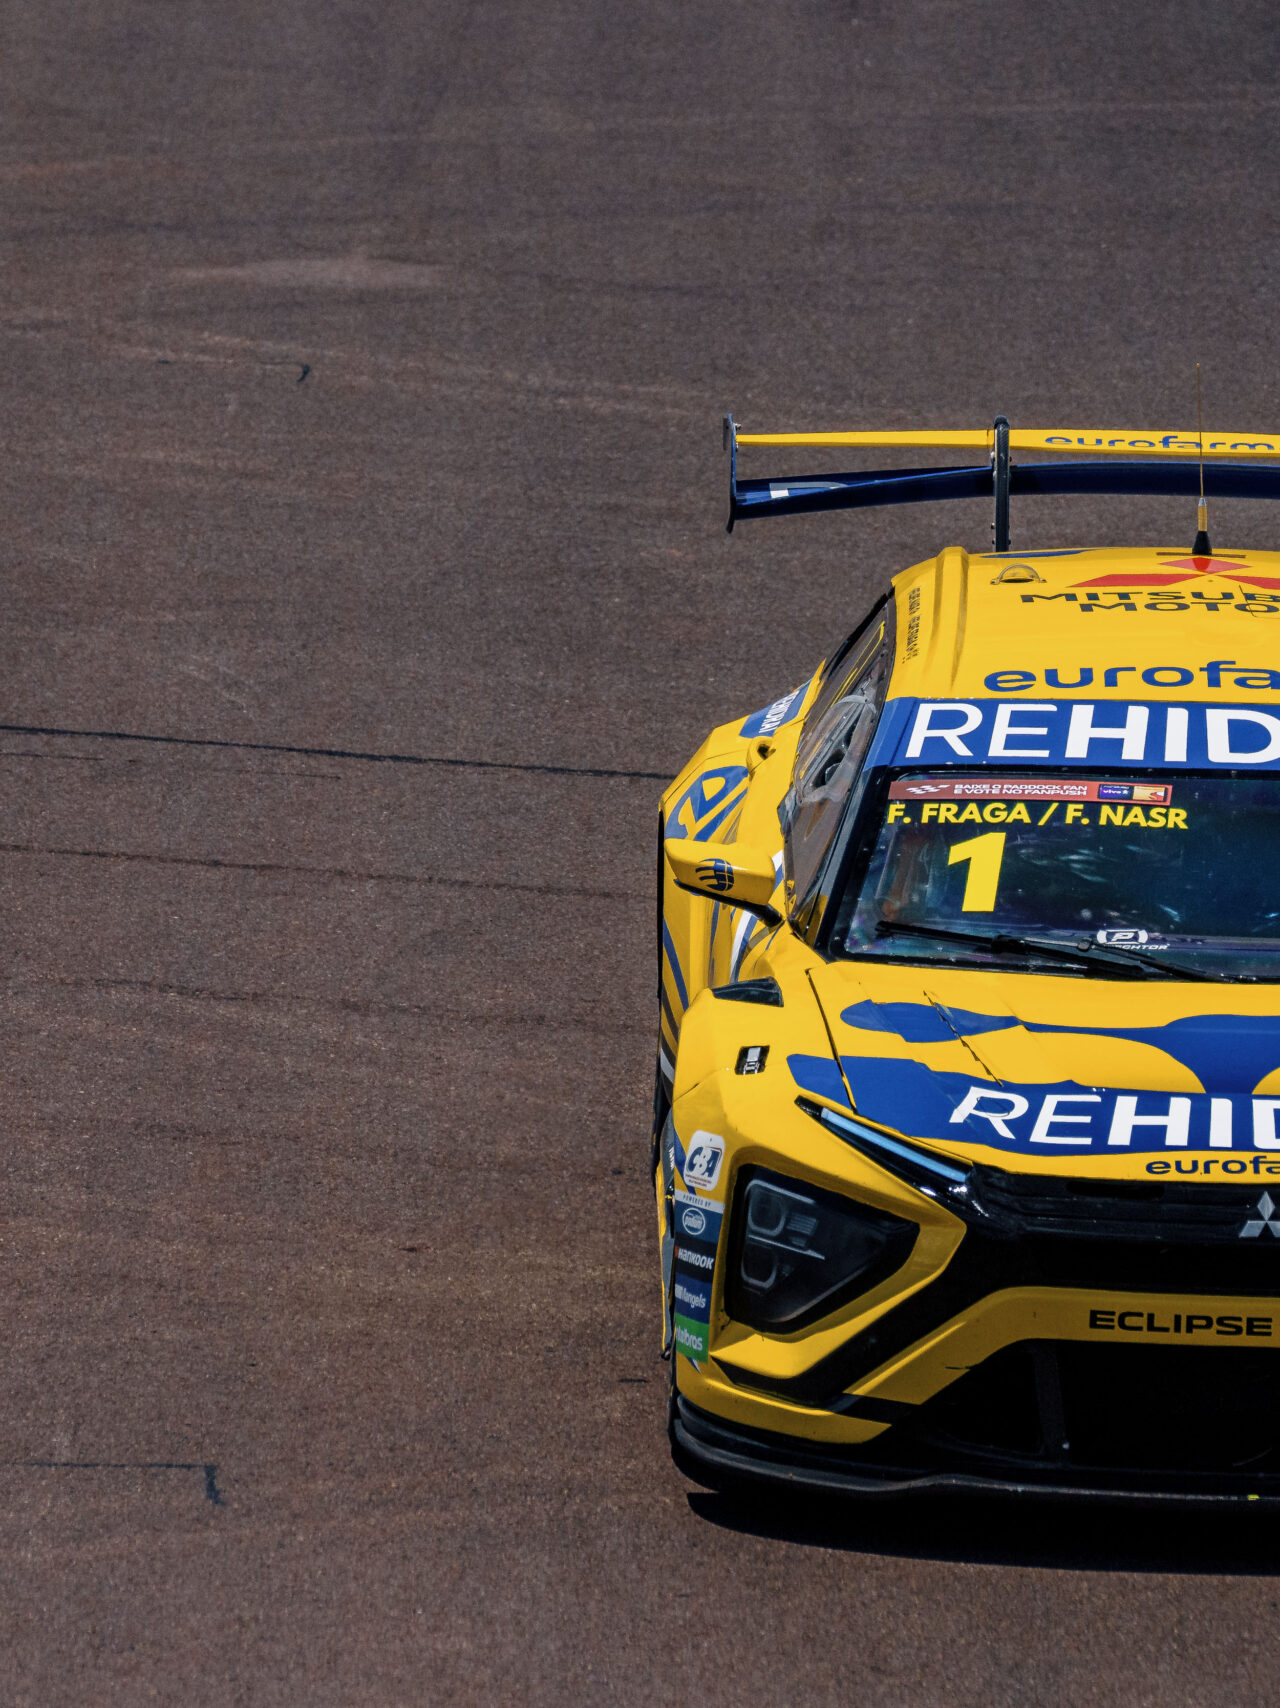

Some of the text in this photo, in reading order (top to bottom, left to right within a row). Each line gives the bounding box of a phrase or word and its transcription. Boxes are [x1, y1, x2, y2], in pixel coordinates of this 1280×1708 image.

[886, 802, 1189, 830] F. FRAGA / F. NASR
[947, 831, 1007, 912] 1
[687, 1146, 720, 1178] CBA
[1089, 1310, 1273, 1336] ECLIPSE
